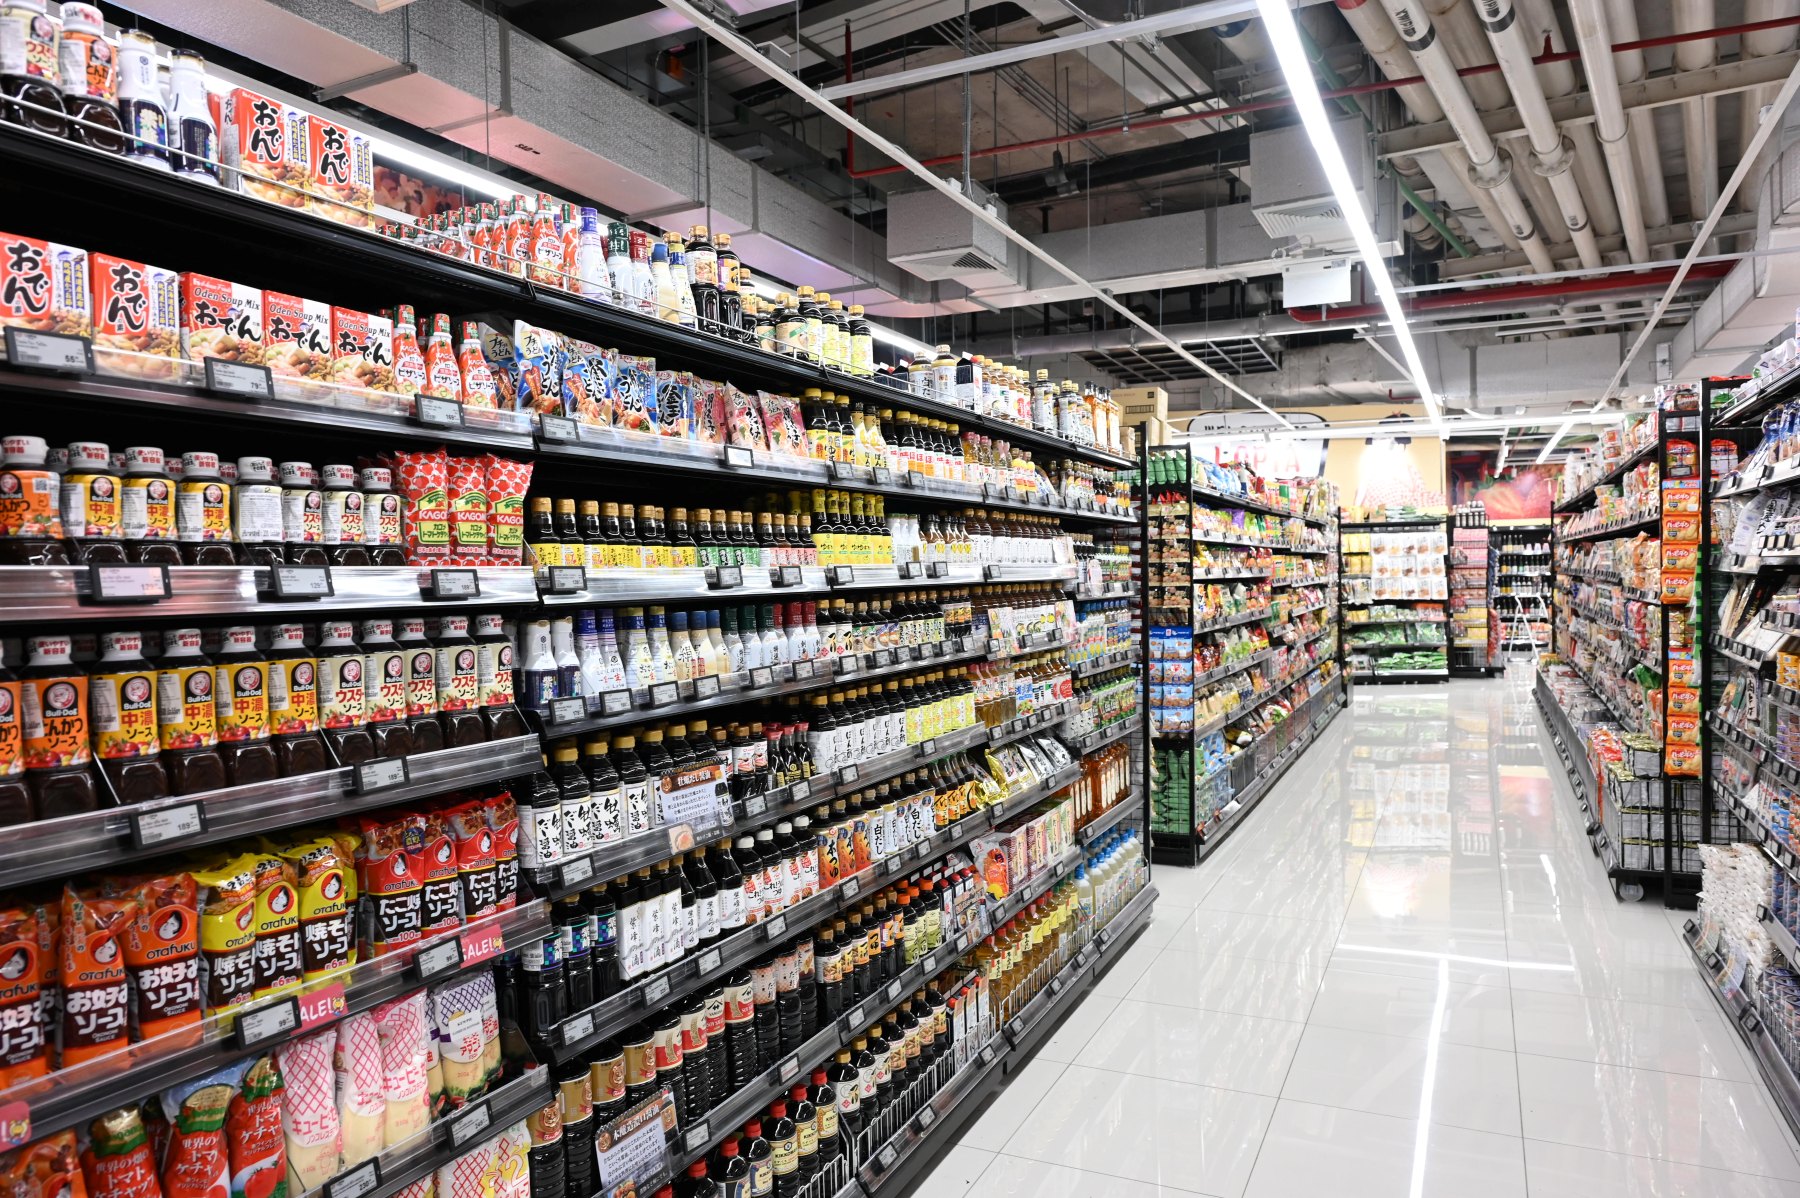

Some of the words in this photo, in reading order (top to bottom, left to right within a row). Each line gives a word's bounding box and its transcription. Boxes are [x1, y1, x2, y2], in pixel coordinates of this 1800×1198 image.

[250, 100, 282, 162] おでん
[320, 126, 349, 184] おでん
[3, 242, 49, 313] おでん
[108, 264, 146, 331] おでん
[194, 288, 219, 301] Oden
[221, 294, 243, 309] Soup
[244, 299, 260, 311] Mix
[195, 300, 261, 342] おでん
[269, 304, 292, 316] Oden
[294, 308, 312, 322] Soup
[313, 313, 328, 325] Mix
[270, 316, 330, 354] おでん
[338, 319, 357, 332] Oden
[359, 323, 377, 337] Soup
[379, 327, 390, 338] Mix
[339, 330, 391, 366] おでん
[89, 503, 115, 514] 中濃
[147, 505, 169, 517] 中濃
[203, 508, 224, 519] 中濃
[93, 515, 114, 523] ソース
[150, 517, 168, 525] ソース
[206, 520, 224, 528] ソース
[291, 692, 316, 707] 中濃
[415, 693, 433, 701] ソース
[458, 689, 476, 697] ソース
[45, 708, 78, 718] Bull-Dog
[185, 704, 213, 720] 中濃
[235, 697, 264, 714] 中濃
[295, 707, 315, 717] ソース
[343, 704, 363, 713] ソース
[121, 710, 153, 728] 中濃
[189, 720, 212, 731] ソース
[239, 713, 263, 724] ソース
[48, 736, 78, 748] ソース
[126, 727, 153, 739] ソース
[911, 808, 921, 839] 白だし
[874, 824, 883, 855] 白だし
[472, 888, 496, 905] ソース
[428, 898, 457, 914] ソース
[382, 914, 416, 932] ソース
[314, 937, 348, 959] ソース
[138, 957, 198, 990] お好み
[260, 957, 300, 976] ソース
[220, 968, 254, 995] ソース
[66, 983, 128, 1014] お好み
[146, 982, 193, 1010] ソース
[75, 1007, 124, 1035] ソース
[107, 1167, 145, 1189] トマト
